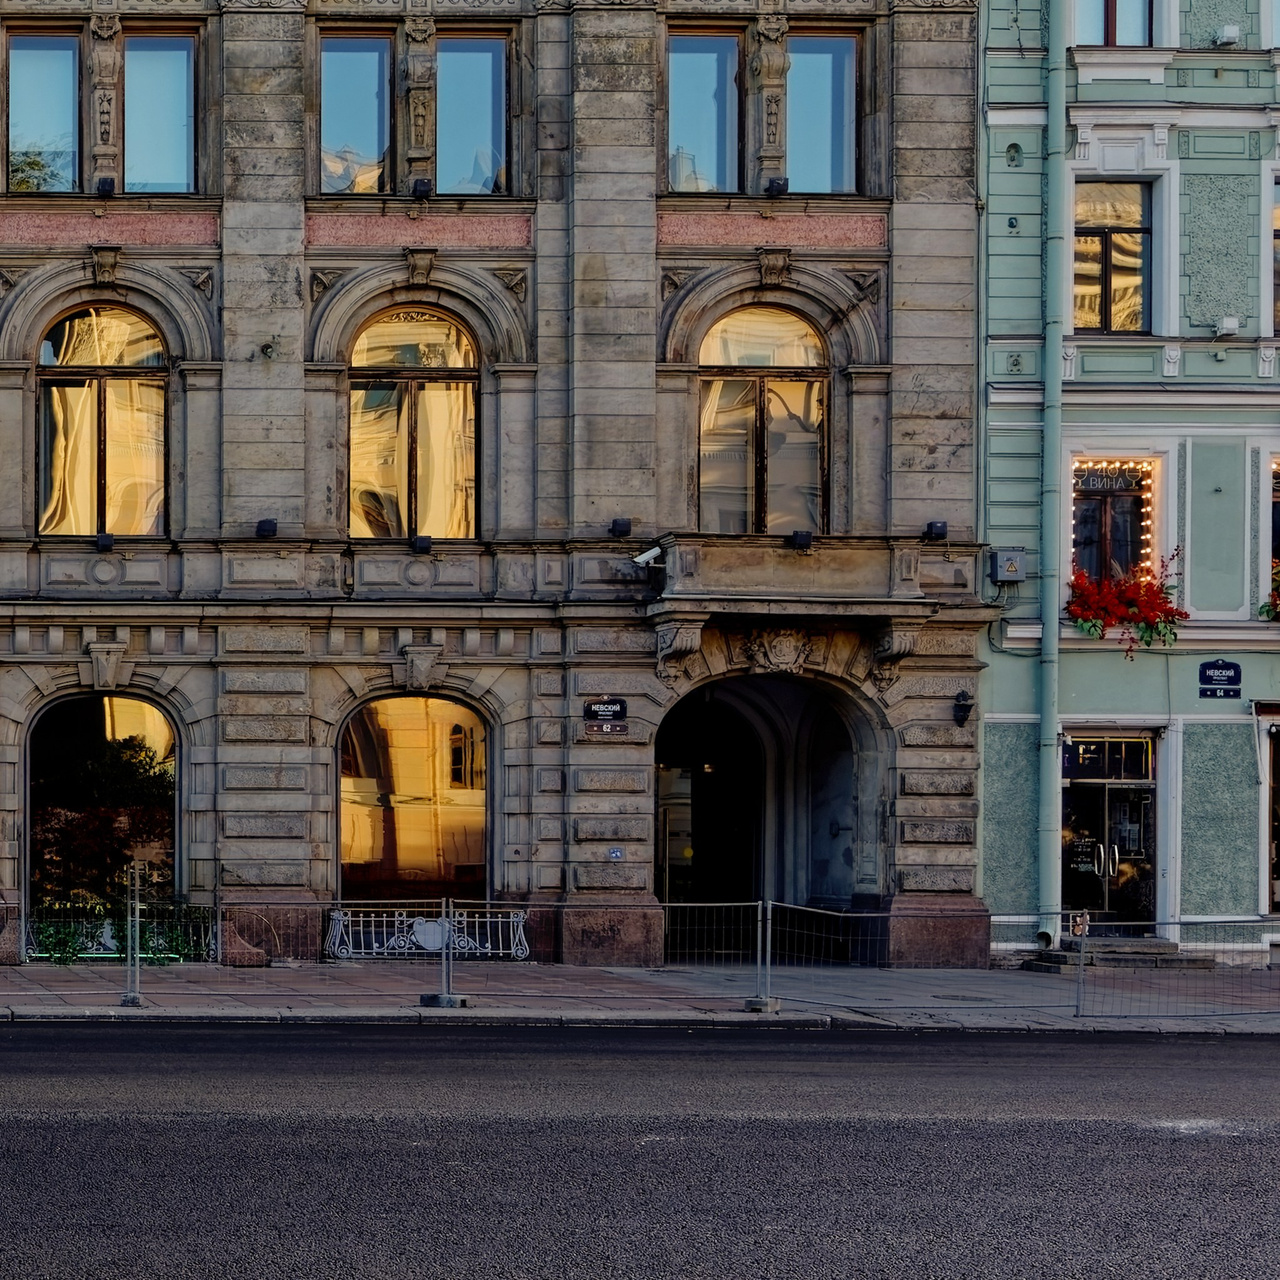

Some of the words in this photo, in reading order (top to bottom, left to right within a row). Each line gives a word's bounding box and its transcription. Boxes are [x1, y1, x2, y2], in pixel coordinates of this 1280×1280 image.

[1089, 477, 1125, 489] ВИНА
[1206, 669, 1235, 677] НЕВСКИЙ
[1216, 689, 1224, 697] 64
[591, 703, 621, 711] НЕВСКИЙ
[602, 724, 611, 732] 62
